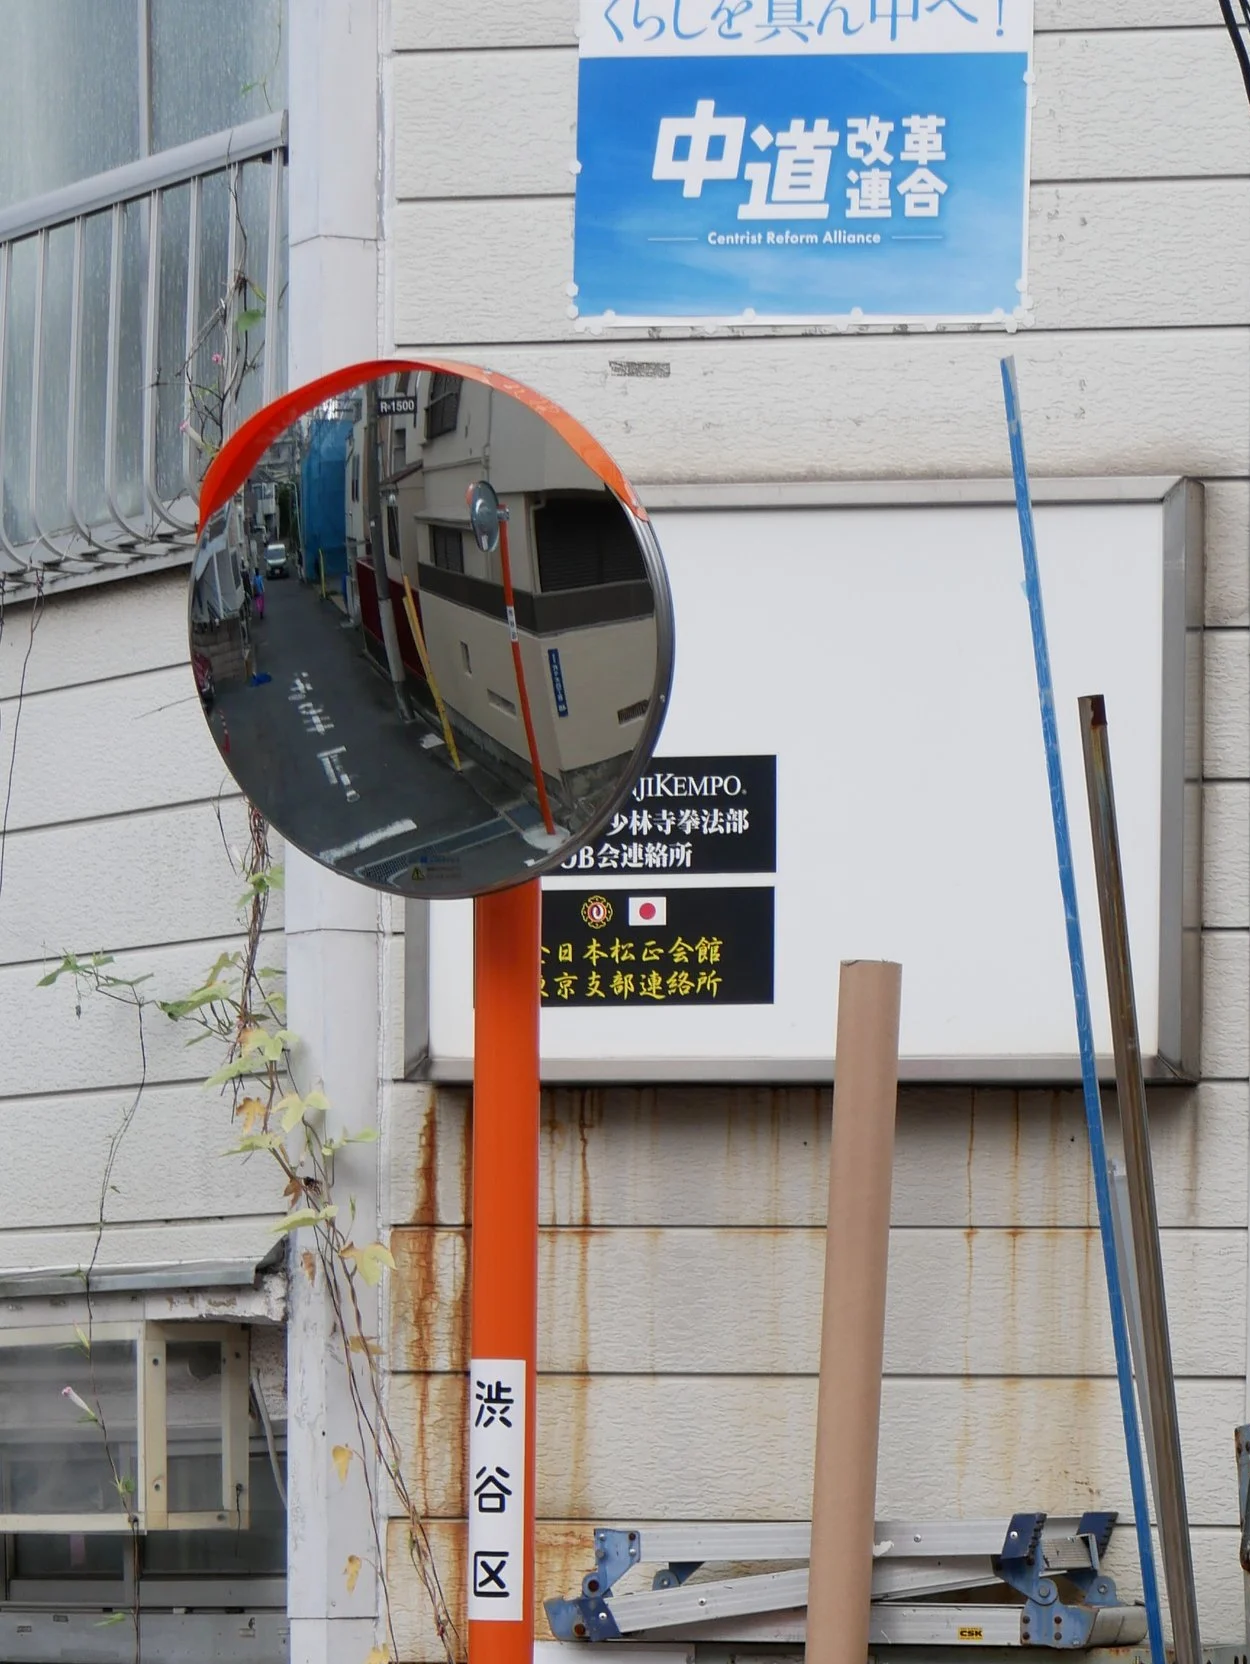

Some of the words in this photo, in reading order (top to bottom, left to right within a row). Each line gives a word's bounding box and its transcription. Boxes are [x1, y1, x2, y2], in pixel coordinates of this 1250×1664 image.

[652, 99, 840, 220] 中道
[846, 114, 946, 166] 改革
[845, 168, 948, 219] 連合
[707, 230, 762, 246] Centrist
[766, 230, 819, 245] Reform
[822, 229, 881, 245] Alliance
[632, 773, 742, 802] JIKEMPO
[473, 1380, 515, 1598] 渋谷区
